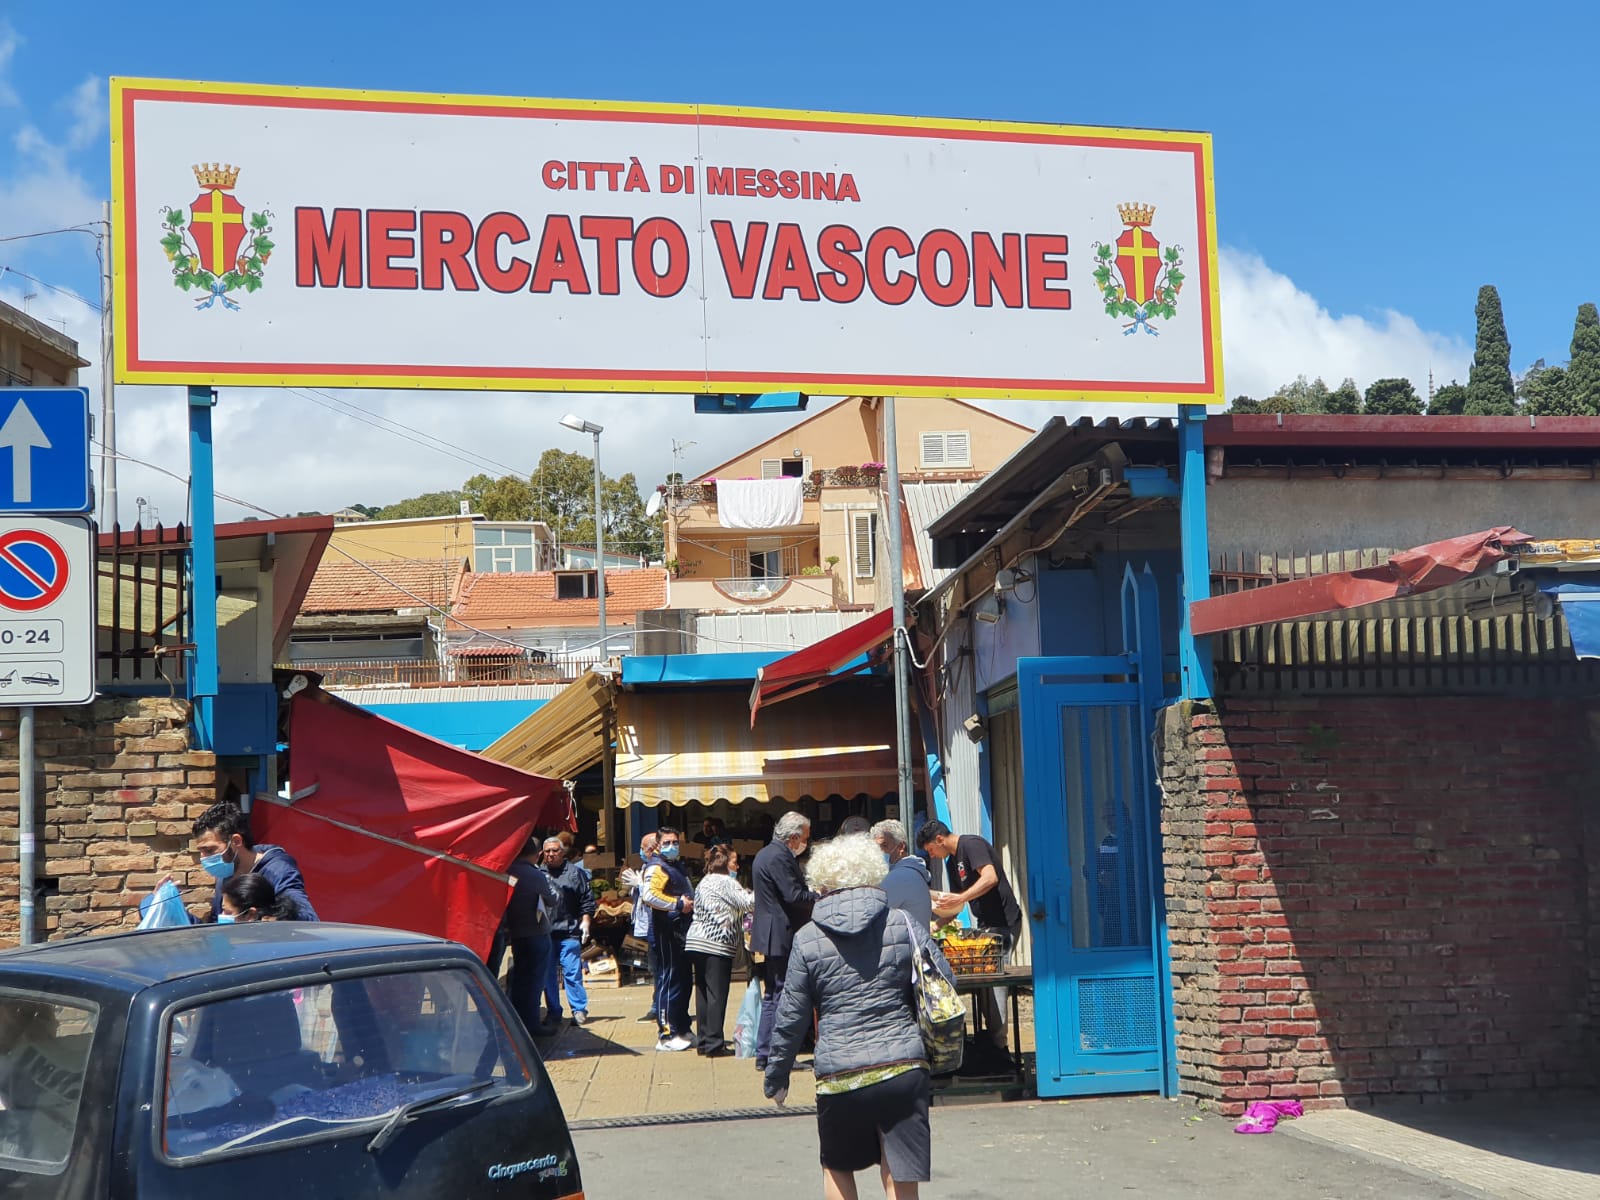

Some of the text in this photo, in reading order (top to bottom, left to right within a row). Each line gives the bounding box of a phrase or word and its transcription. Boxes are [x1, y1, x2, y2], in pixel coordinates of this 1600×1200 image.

[541, 156, 861, 202] CITTÀ DI MESSINA
[295, 206, 1072, 311] MERCATO VASCONE
[488, 1153, 557, 1179] Cinquecento
